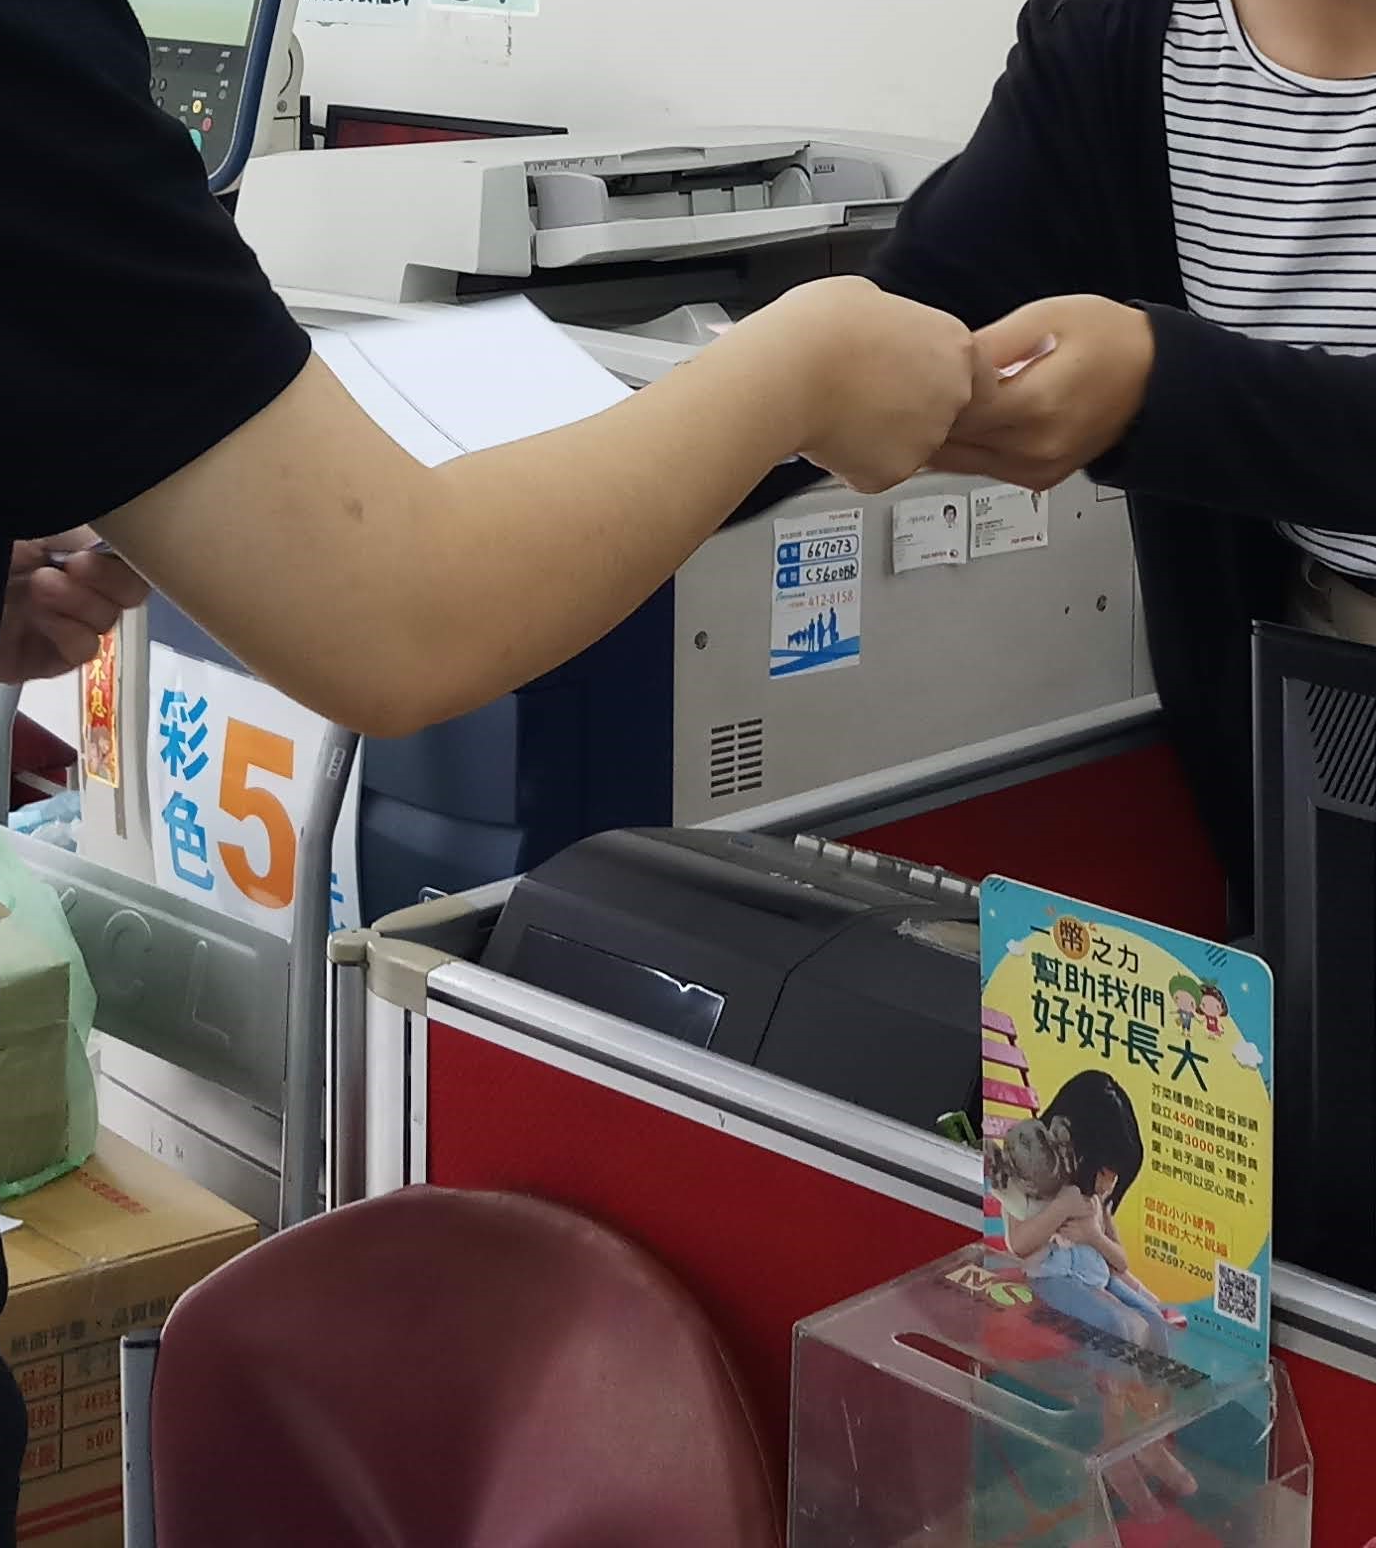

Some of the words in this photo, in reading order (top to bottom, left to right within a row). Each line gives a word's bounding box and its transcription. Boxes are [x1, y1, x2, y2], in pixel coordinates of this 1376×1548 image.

[807, 538, 852, 559] 667073
[159, 688, 215, 891] 彩色
[217, 716, 297, 909] 5
[1030, 920, 1139, 974] 一幣之力
[1031, 952, 1166, 1028] 幫助我們
[1031, 989, 1209, 1092] 好好長大
